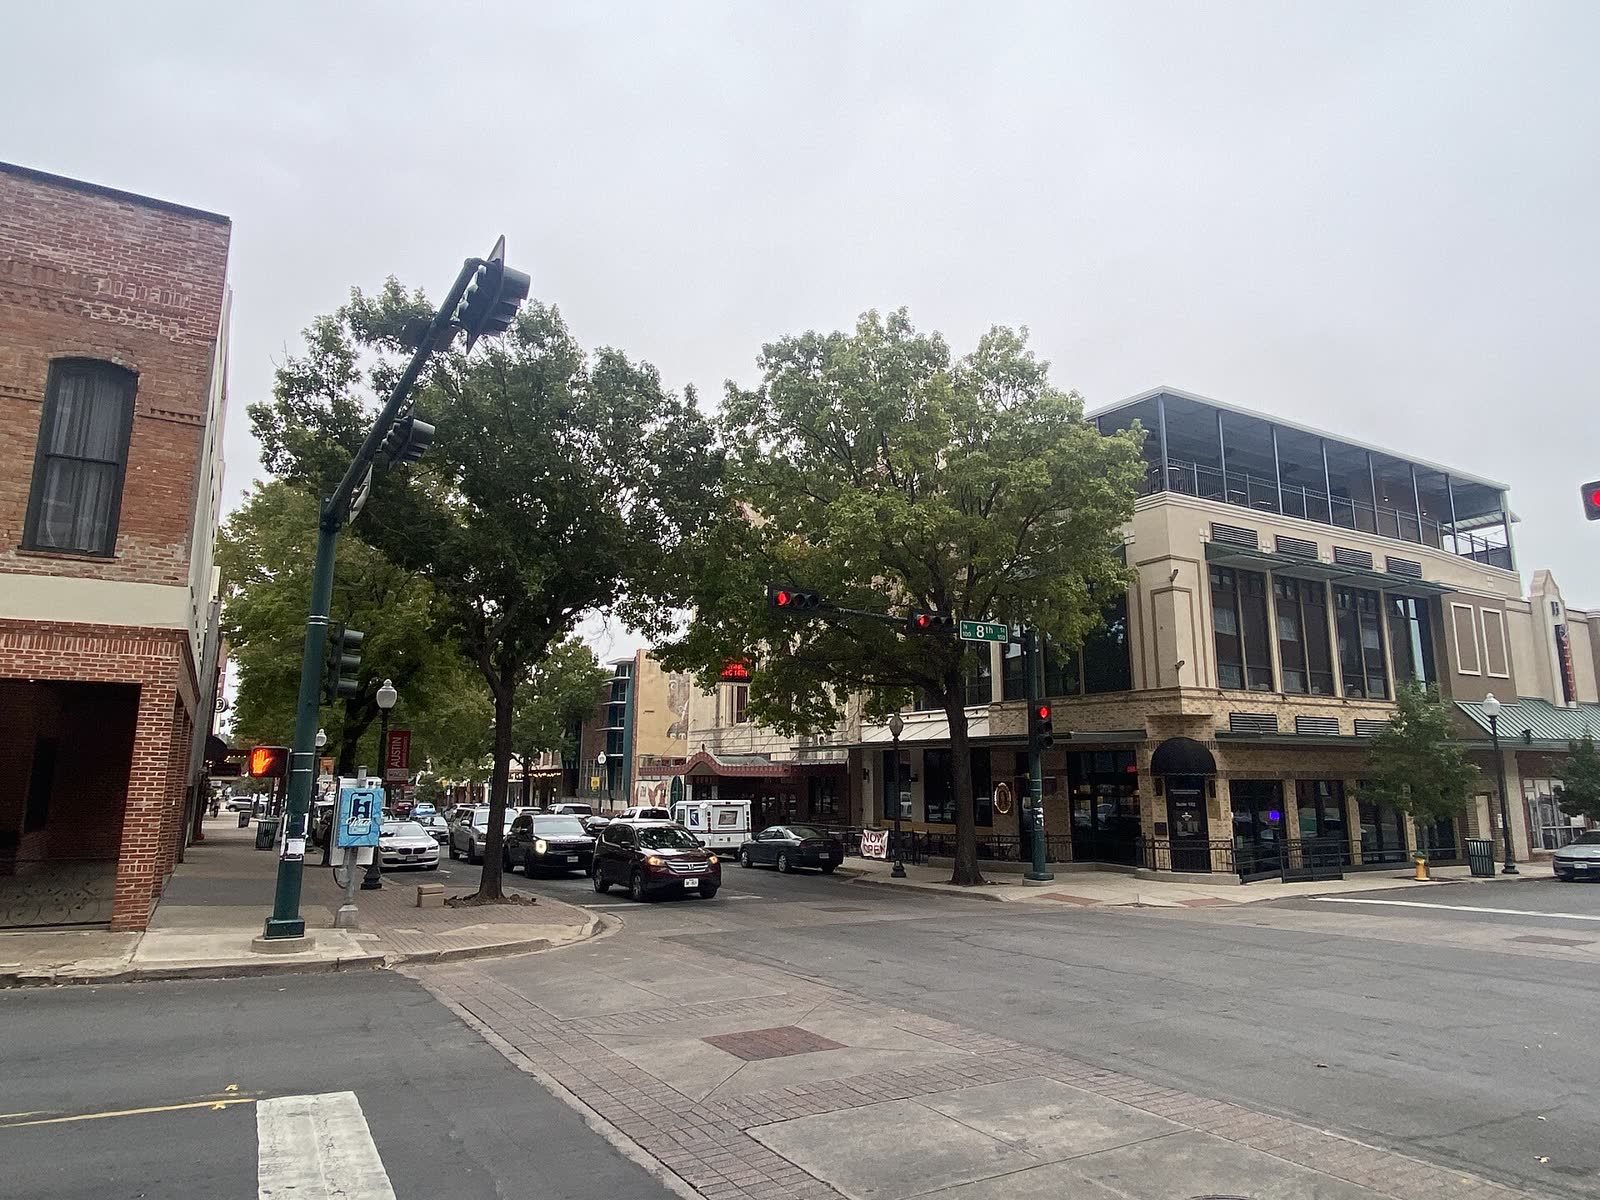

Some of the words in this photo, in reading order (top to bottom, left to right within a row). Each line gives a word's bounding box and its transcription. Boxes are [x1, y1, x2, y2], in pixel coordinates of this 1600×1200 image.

[976, 625, 994, 638] 8th
[391, 736, 402, 767] AUSTIN
[863, 832, 885, 843] NOW
[863, 843, 886, 856] OPEN
